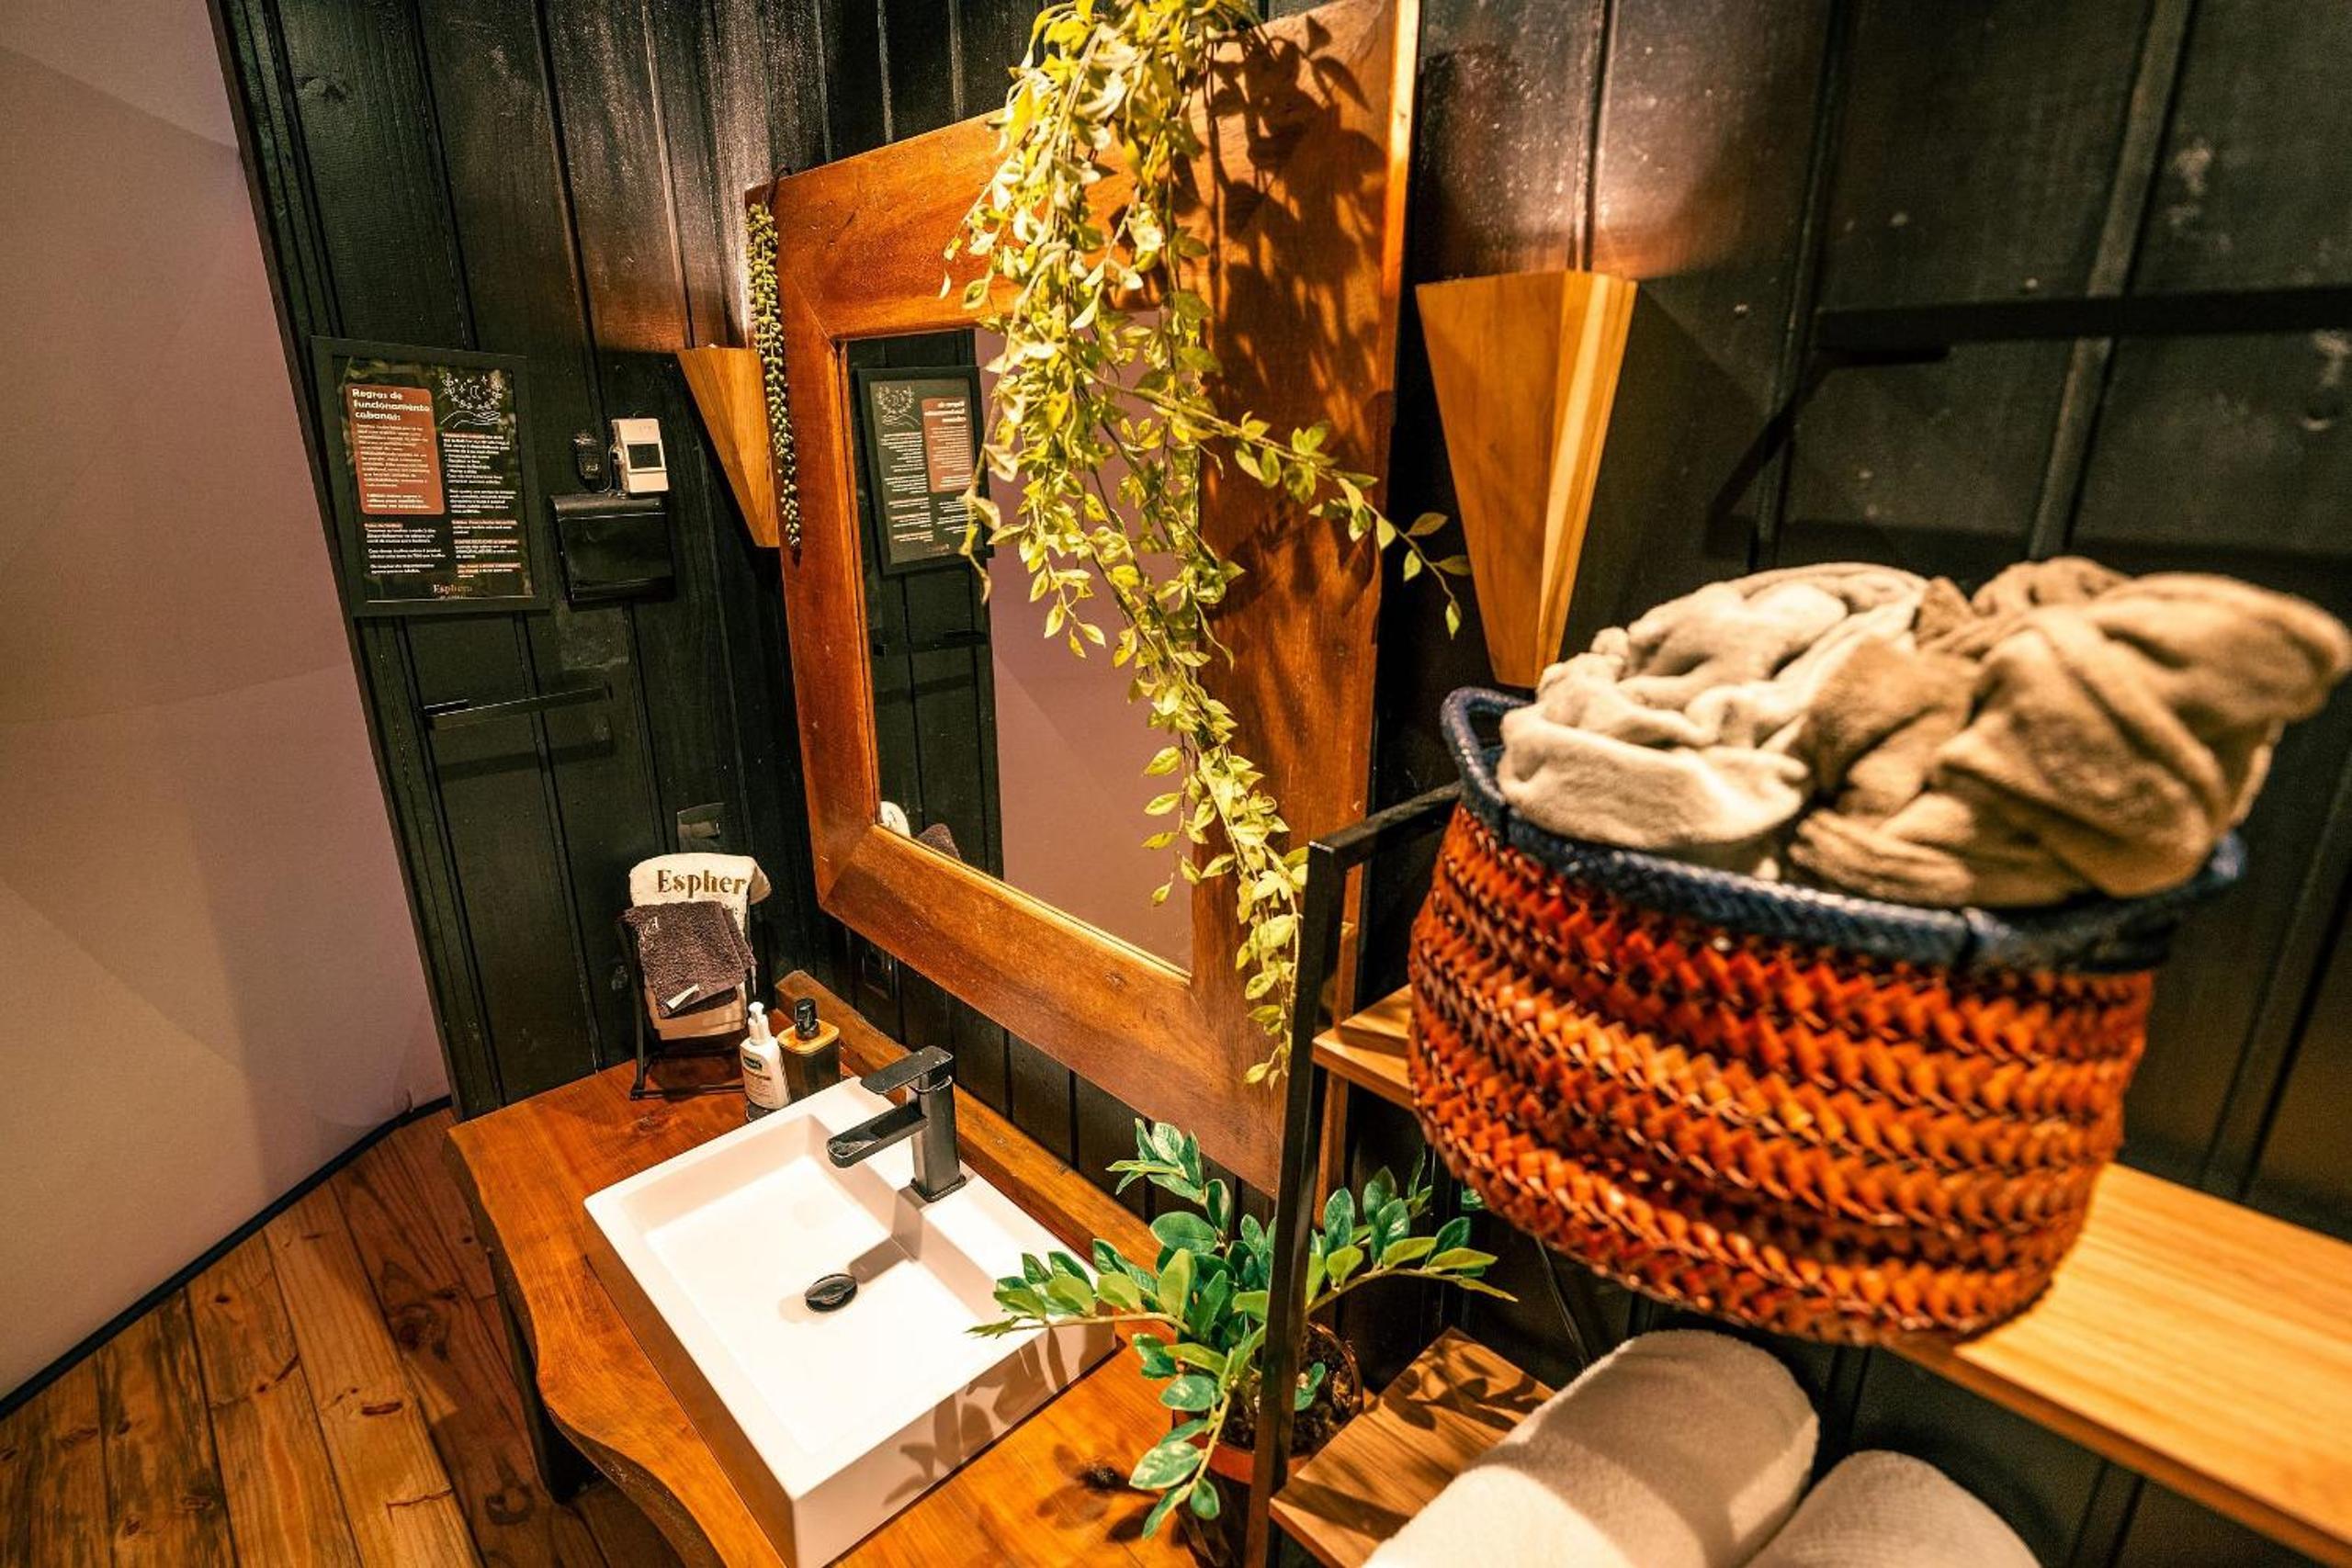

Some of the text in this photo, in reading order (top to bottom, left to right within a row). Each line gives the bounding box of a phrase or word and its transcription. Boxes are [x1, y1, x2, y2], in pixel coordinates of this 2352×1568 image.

[352, 389, 402, 400] Regras de
[353, 400, 430, 412] funcionamento
